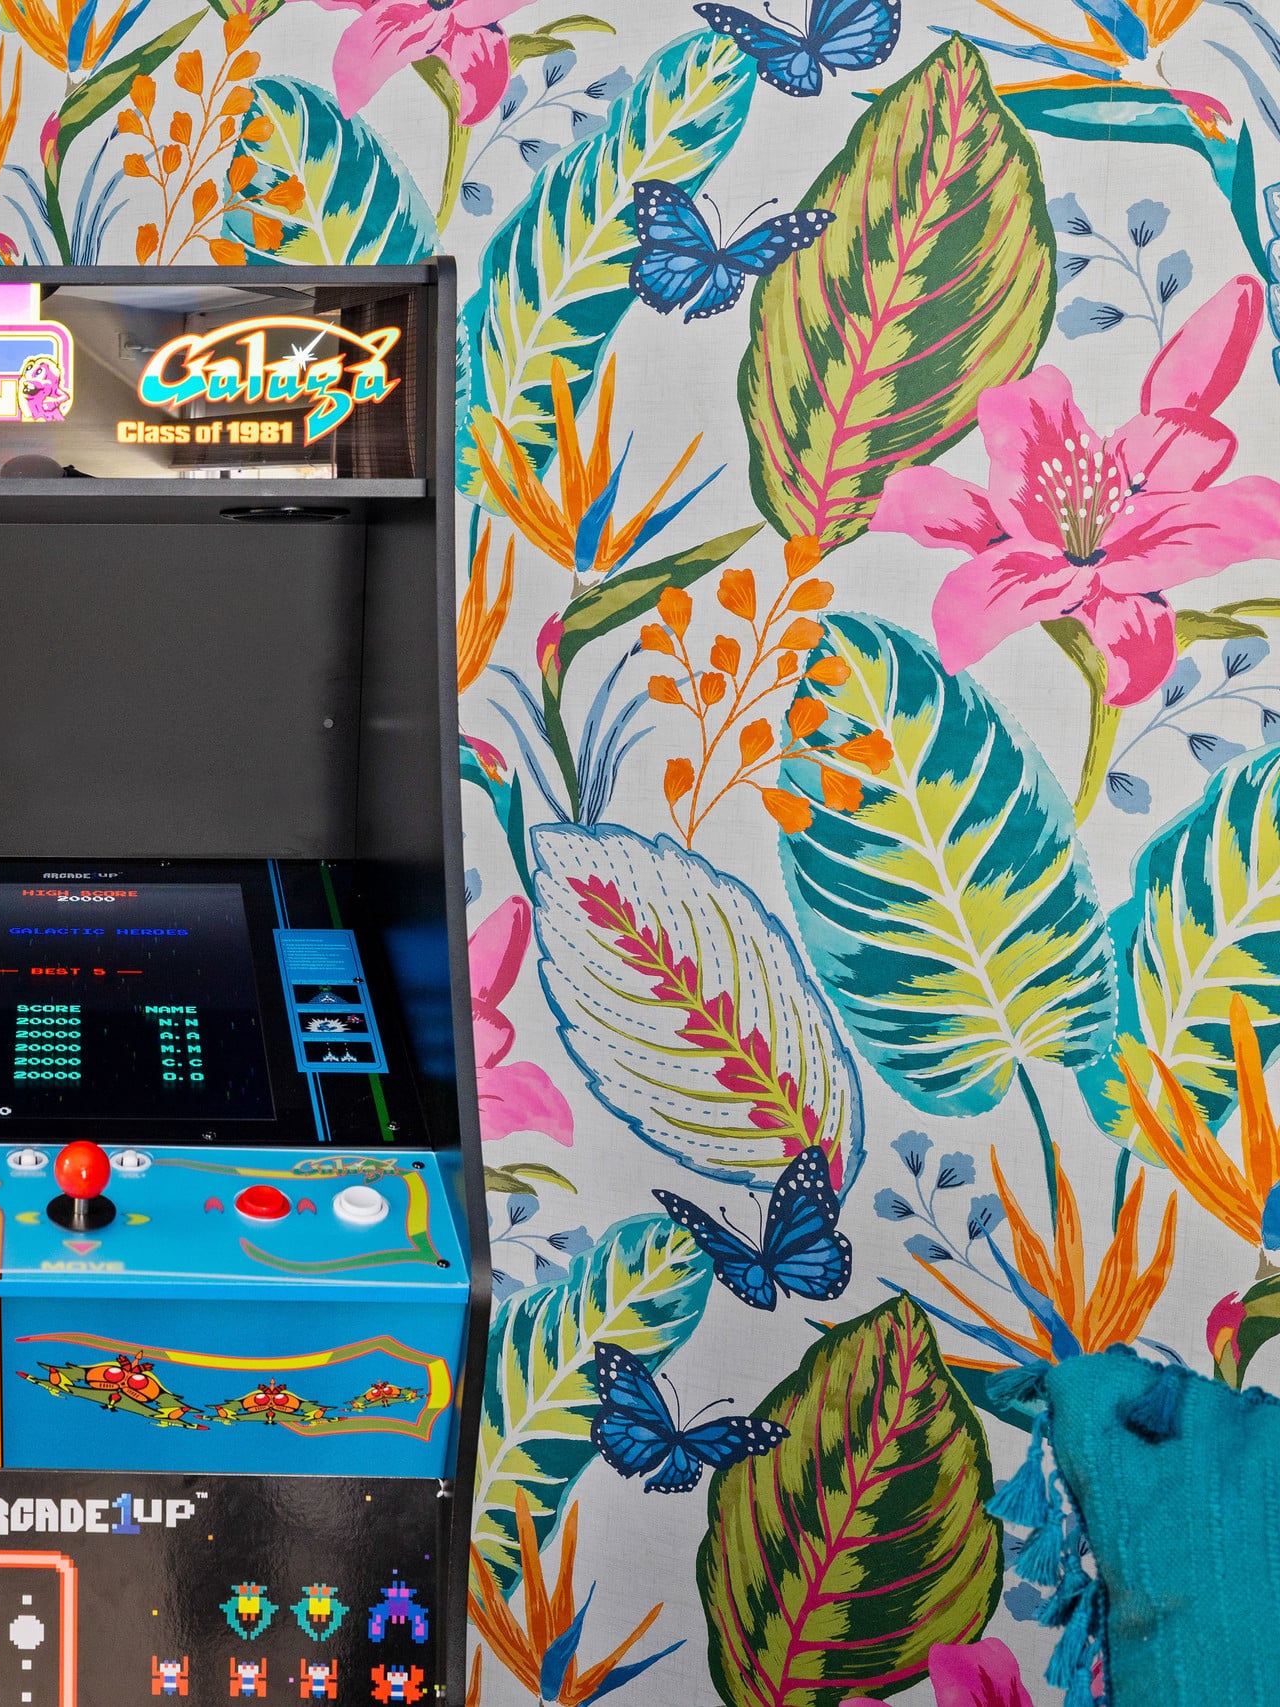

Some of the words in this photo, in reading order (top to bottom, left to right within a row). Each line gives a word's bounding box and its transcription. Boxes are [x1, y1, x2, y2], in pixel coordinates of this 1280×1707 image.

[137, 315, 402, 447] Galaga
[117, 421, 191, 444] Class
[195, 421, 223, 444] of
[226, 421, 293, 444] 1981
[21, 889, 70, 897] HIGH
[80, 890, 139, 898] SCORE
[8, 927, 105, 936] GALACTIC
[115, 928, 190, 936] HEROES
[30, 967, 80, 976] BEST
[93, 968, 106, 976] 5
[17, 1005, 81, 1013] SCORE
[145, 1006, 198, 1014] NAME
[16, 1017, 81, 1025] 20000
[15, 1030, 81, 1038] 20000
[14, 1043, 81, 1052] 20000
[14, 1057, 81, 1066] 20000
[13, 1071, 81, 1080] 20000
[41, 1260, 124, 1273] MOVE
